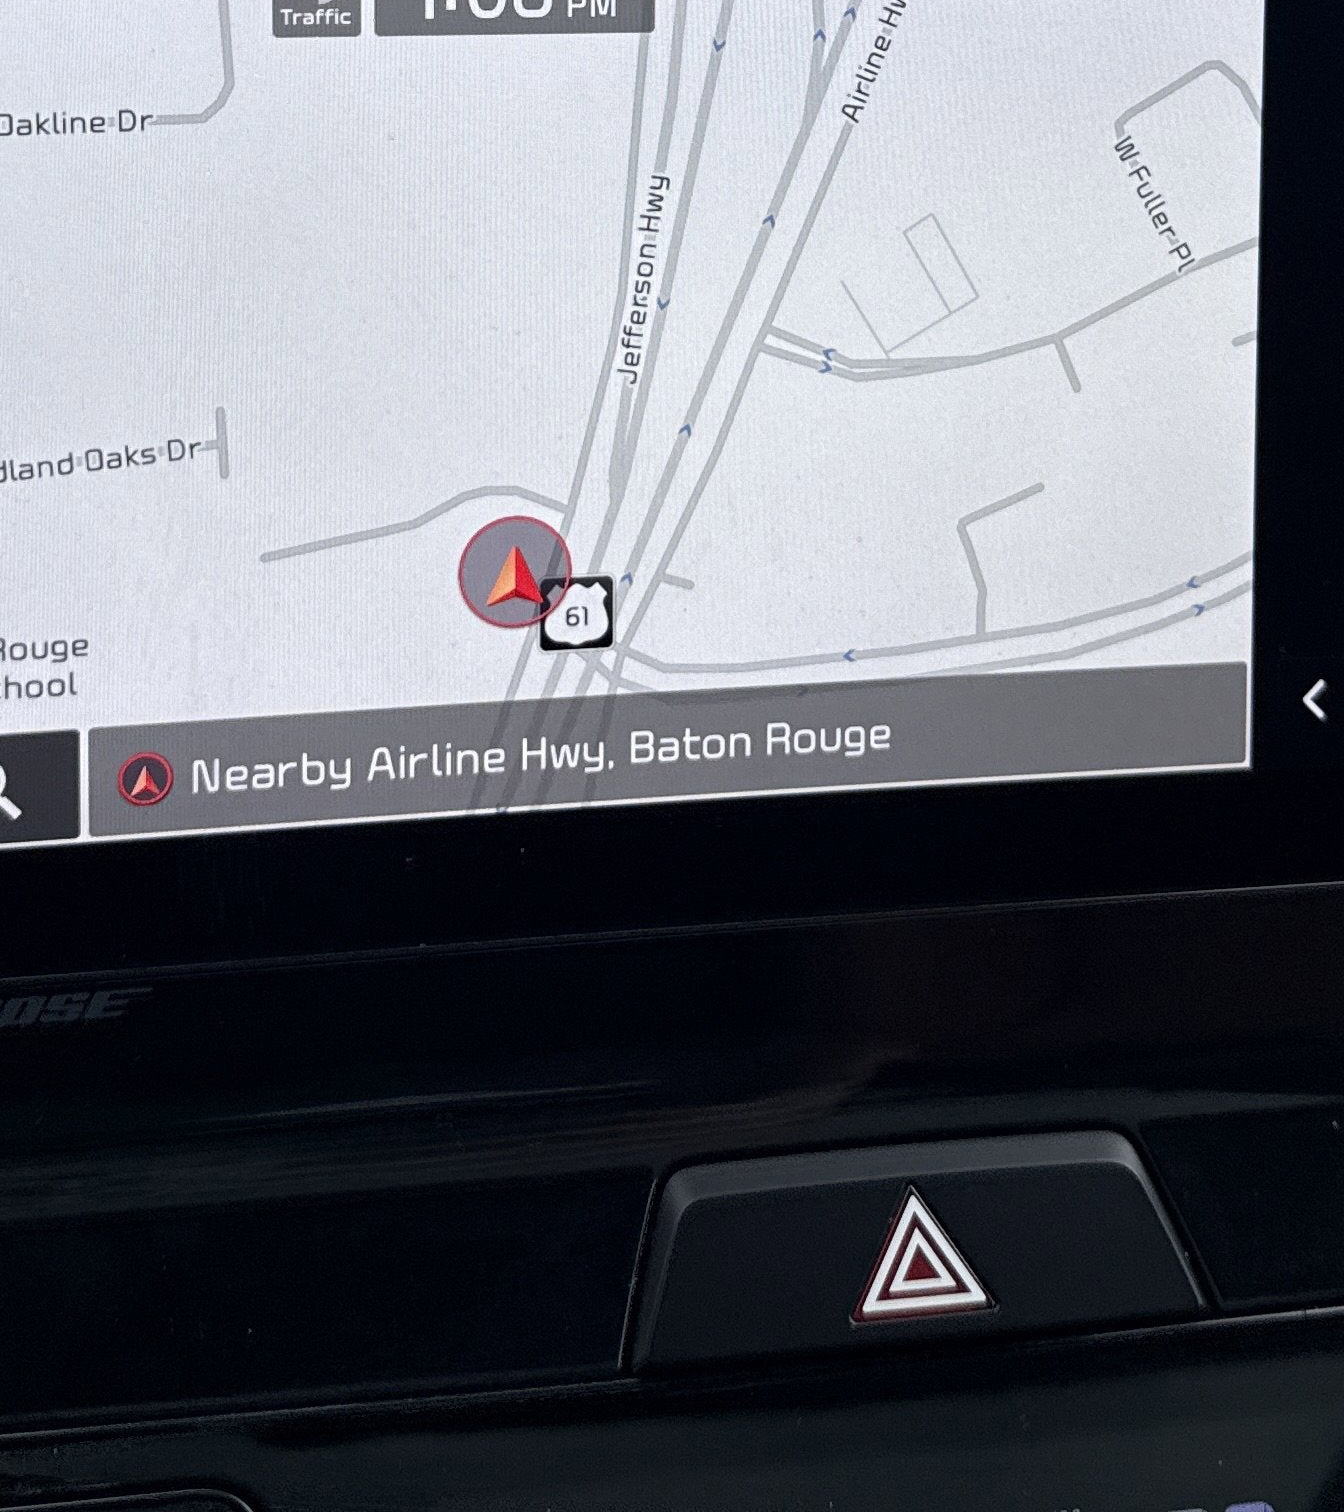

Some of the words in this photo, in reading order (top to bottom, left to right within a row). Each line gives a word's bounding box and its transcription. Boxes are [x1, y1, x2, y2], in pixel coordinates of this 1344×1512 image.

[280, 7, 352, 27] Traffic
[842, 34, 892, 124] Airline
[118, 109, 154, 134] Dr
[1114, 135, 1140, 162] W
[1128, 165, 1176, 237] Fuller
[1168, 241, 1196, 273] Pl
[616, 243, 657, 385] Jefferson
[637, 173, 671, 234] Hwy
[84, 445, 158, 472] Oaks
[167, 438, 202, 461] Dr
[566, 606, 588, 627] 61
[191, 753, 352, 794] Nearby
[367, 741, 506, 782] Airline
[630, 727, 752, 764] Baton
[765, 718, 892, 757] Rouge
